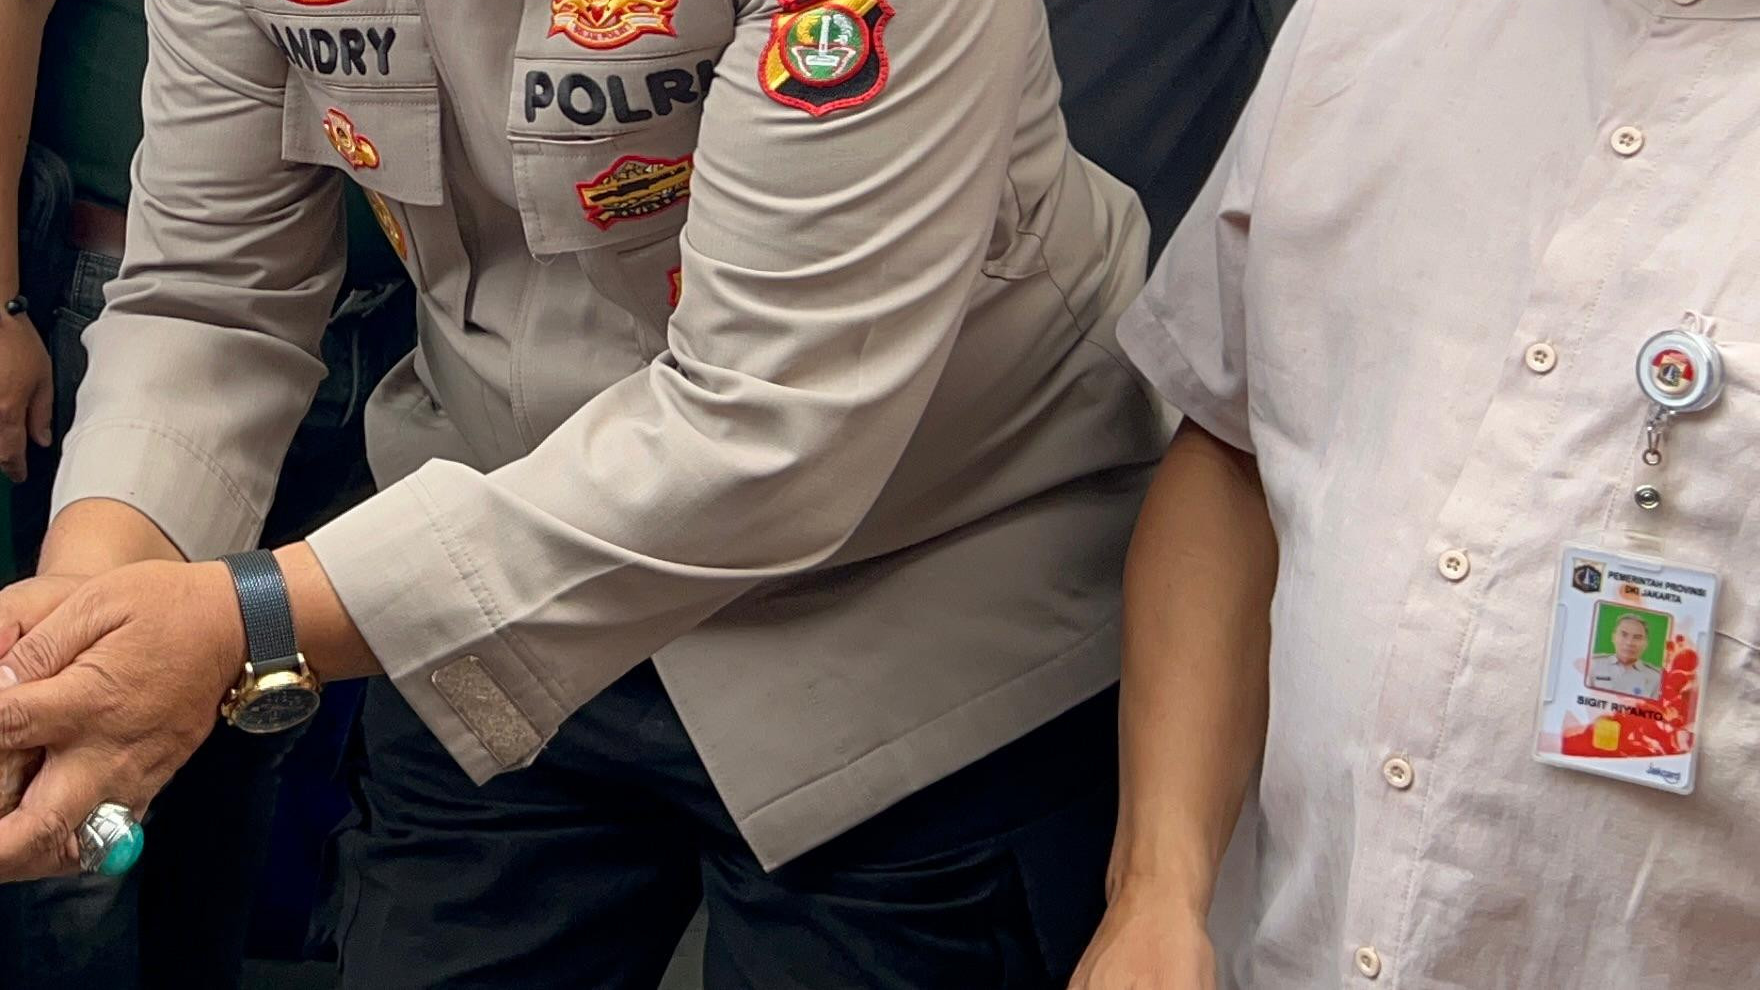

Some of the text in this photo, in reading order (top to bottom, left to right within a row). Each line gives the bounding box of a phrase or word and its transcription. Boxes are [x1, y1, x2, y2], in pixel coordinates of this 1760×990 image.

[1608, 570, 1707, 598] PEMERINTAH PROVINSI
[1641, 589, 1683, 604] JAKARTA
[1577, 695, 1665, 722] SIGIT RIYANTO
